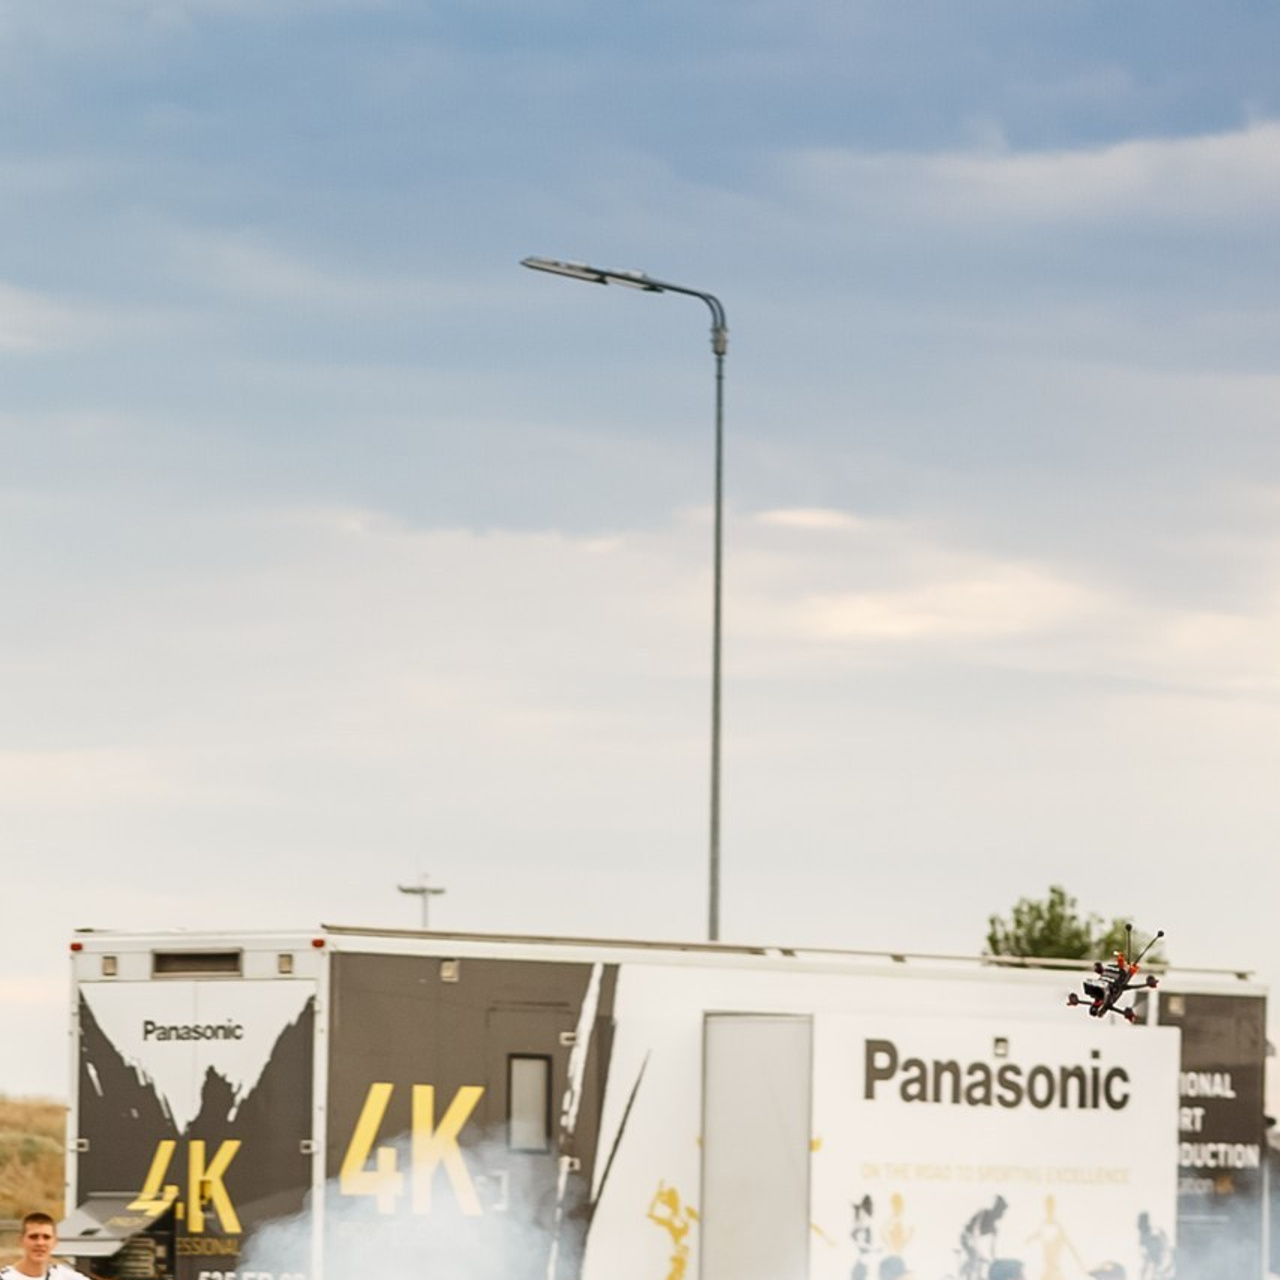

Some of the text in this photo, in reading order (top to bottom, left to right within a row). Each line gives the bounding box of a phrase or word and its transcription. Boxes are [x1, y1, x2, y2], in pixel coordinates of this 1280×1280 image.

[143, 1020, 244, 1041] Panasonic
[864, 1038, 1130, 1111] Panasonic
[1179, 1072, 1236, 1098] IONAL
[1179, 1107, 1205, 1132] RT
[340, 1082, 485, 1216] 4K
[1179, 1143, 1260, 1168] DUCTION
[126, 1139, 242, 1233] 4K
[176, 1237, 241, 1256] ESSIONAL
